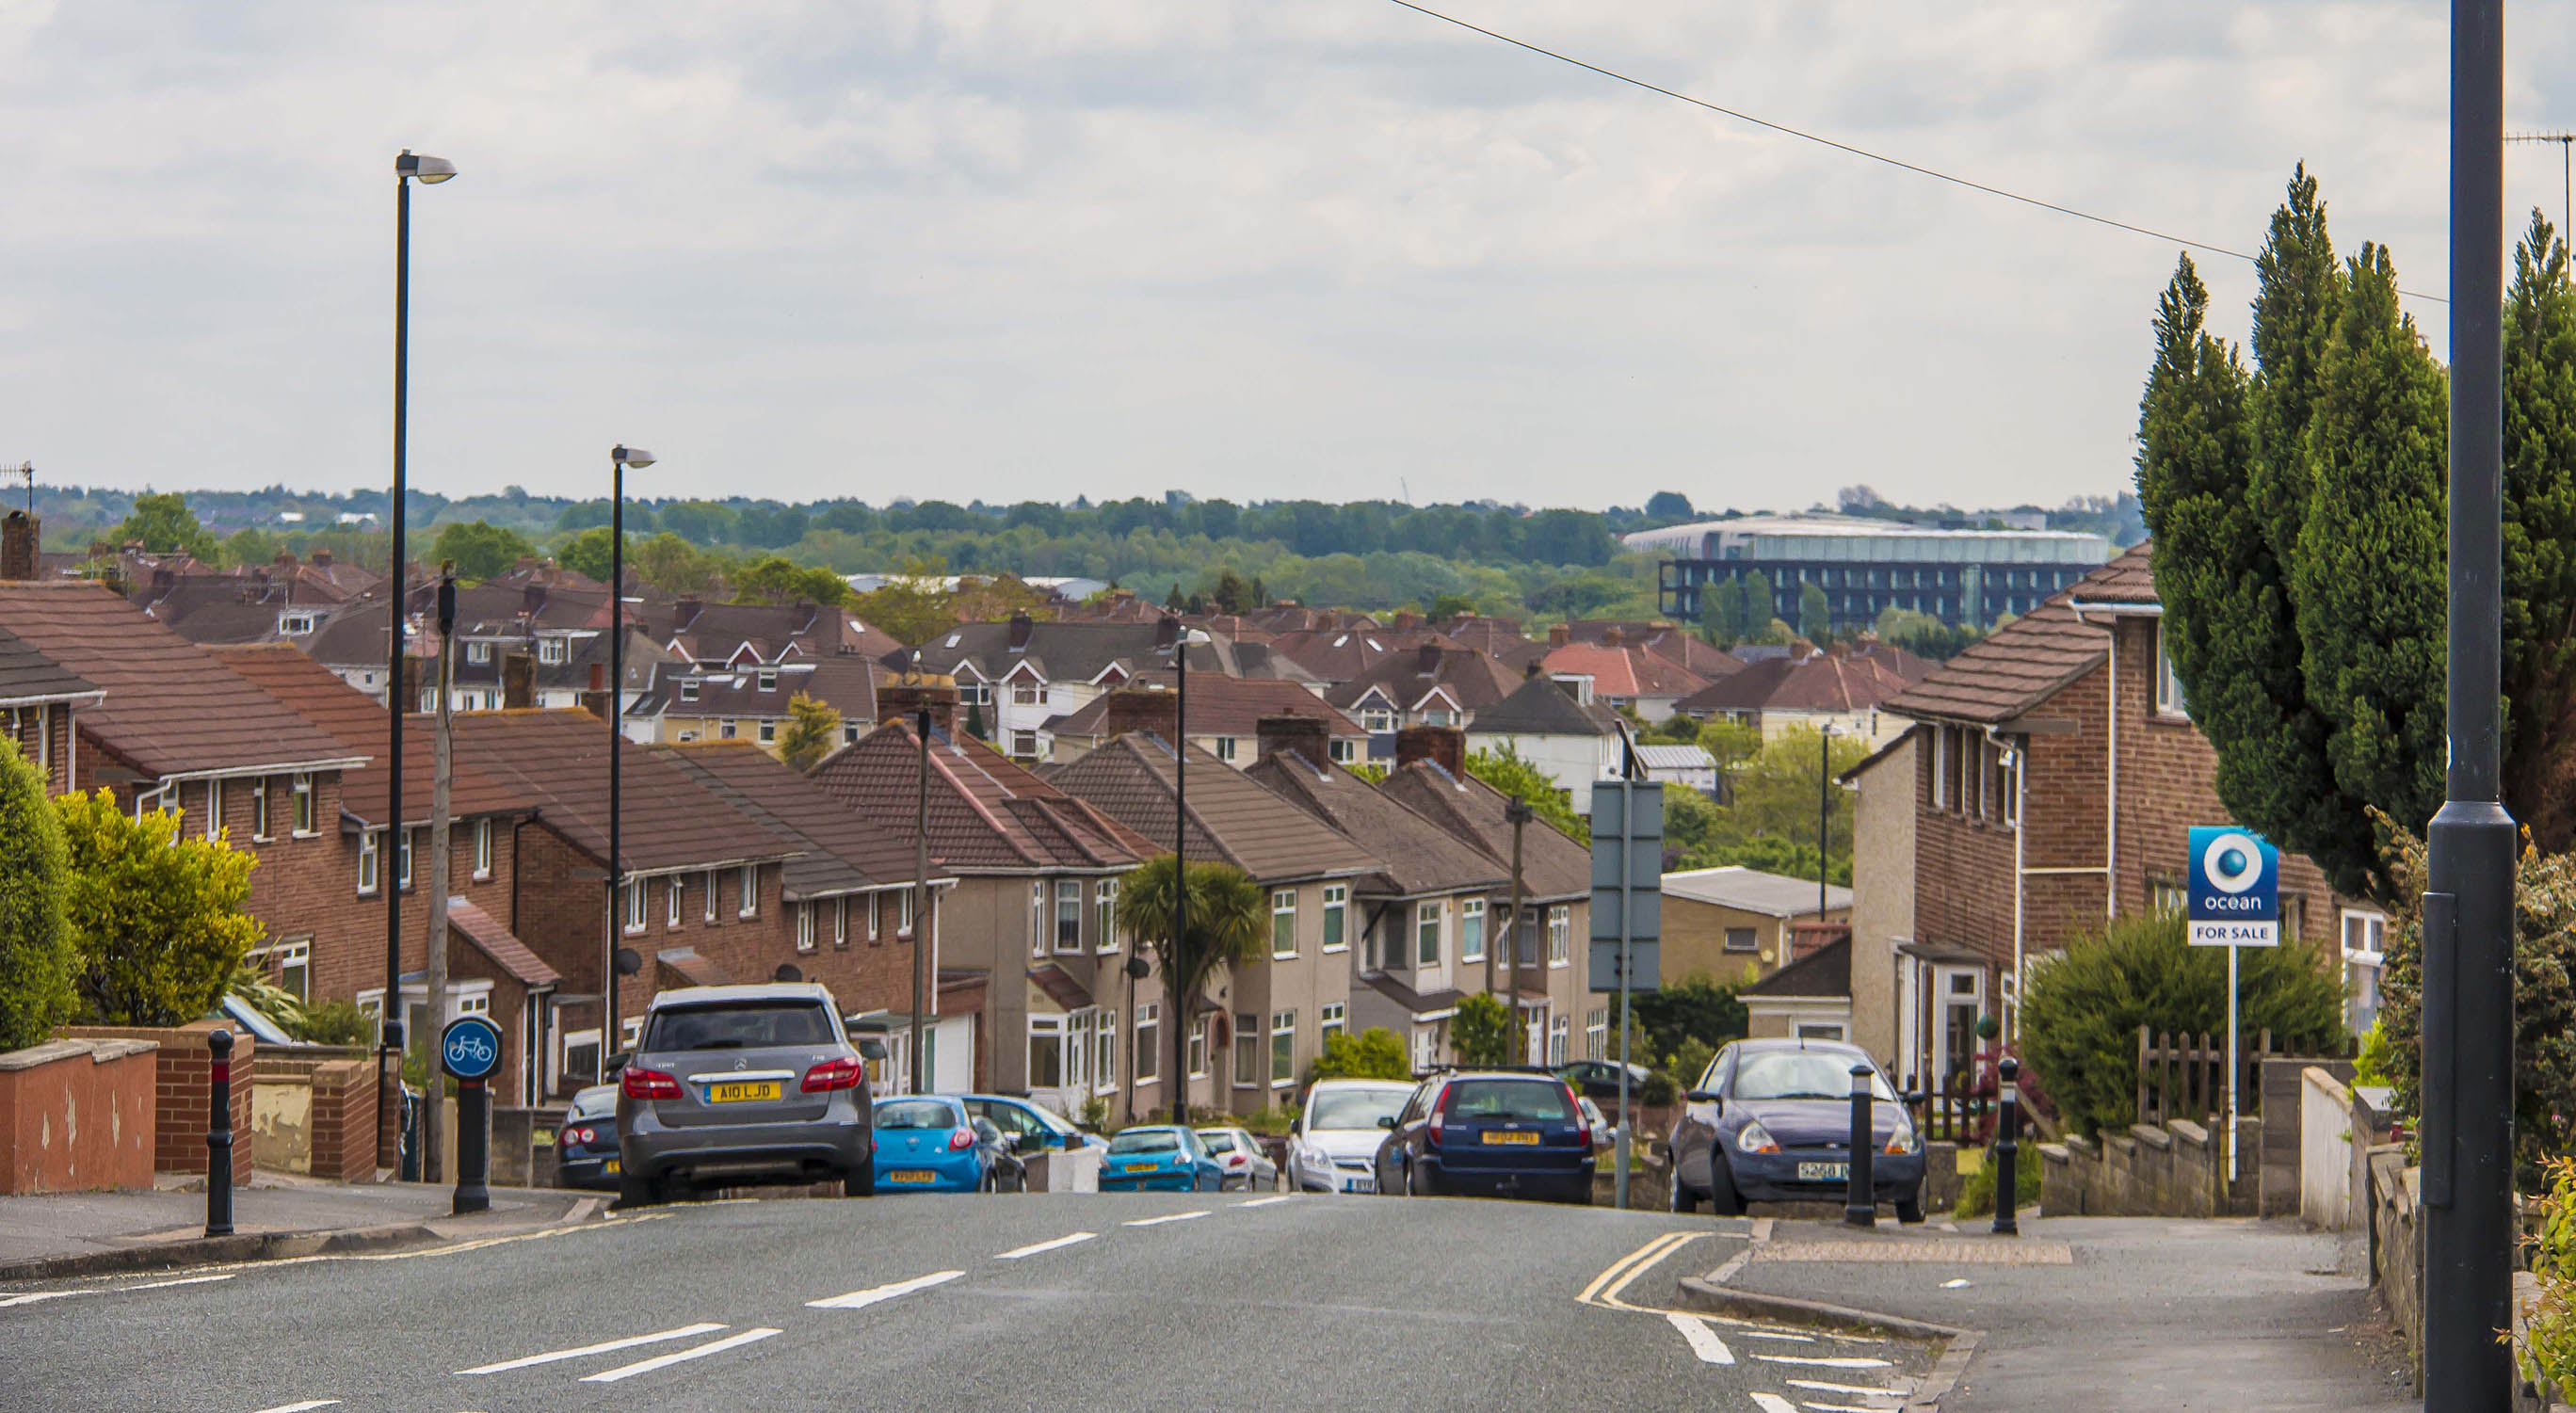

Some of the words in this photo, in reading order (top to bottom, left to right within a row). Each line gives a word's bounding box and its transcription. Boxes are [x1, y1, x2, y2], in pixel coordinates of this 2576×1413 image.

[2205, 896, 2262, 911] ocean
[2197, 926, 2227, 939] FOR
[2231, 926, 2268, 939] SALE
